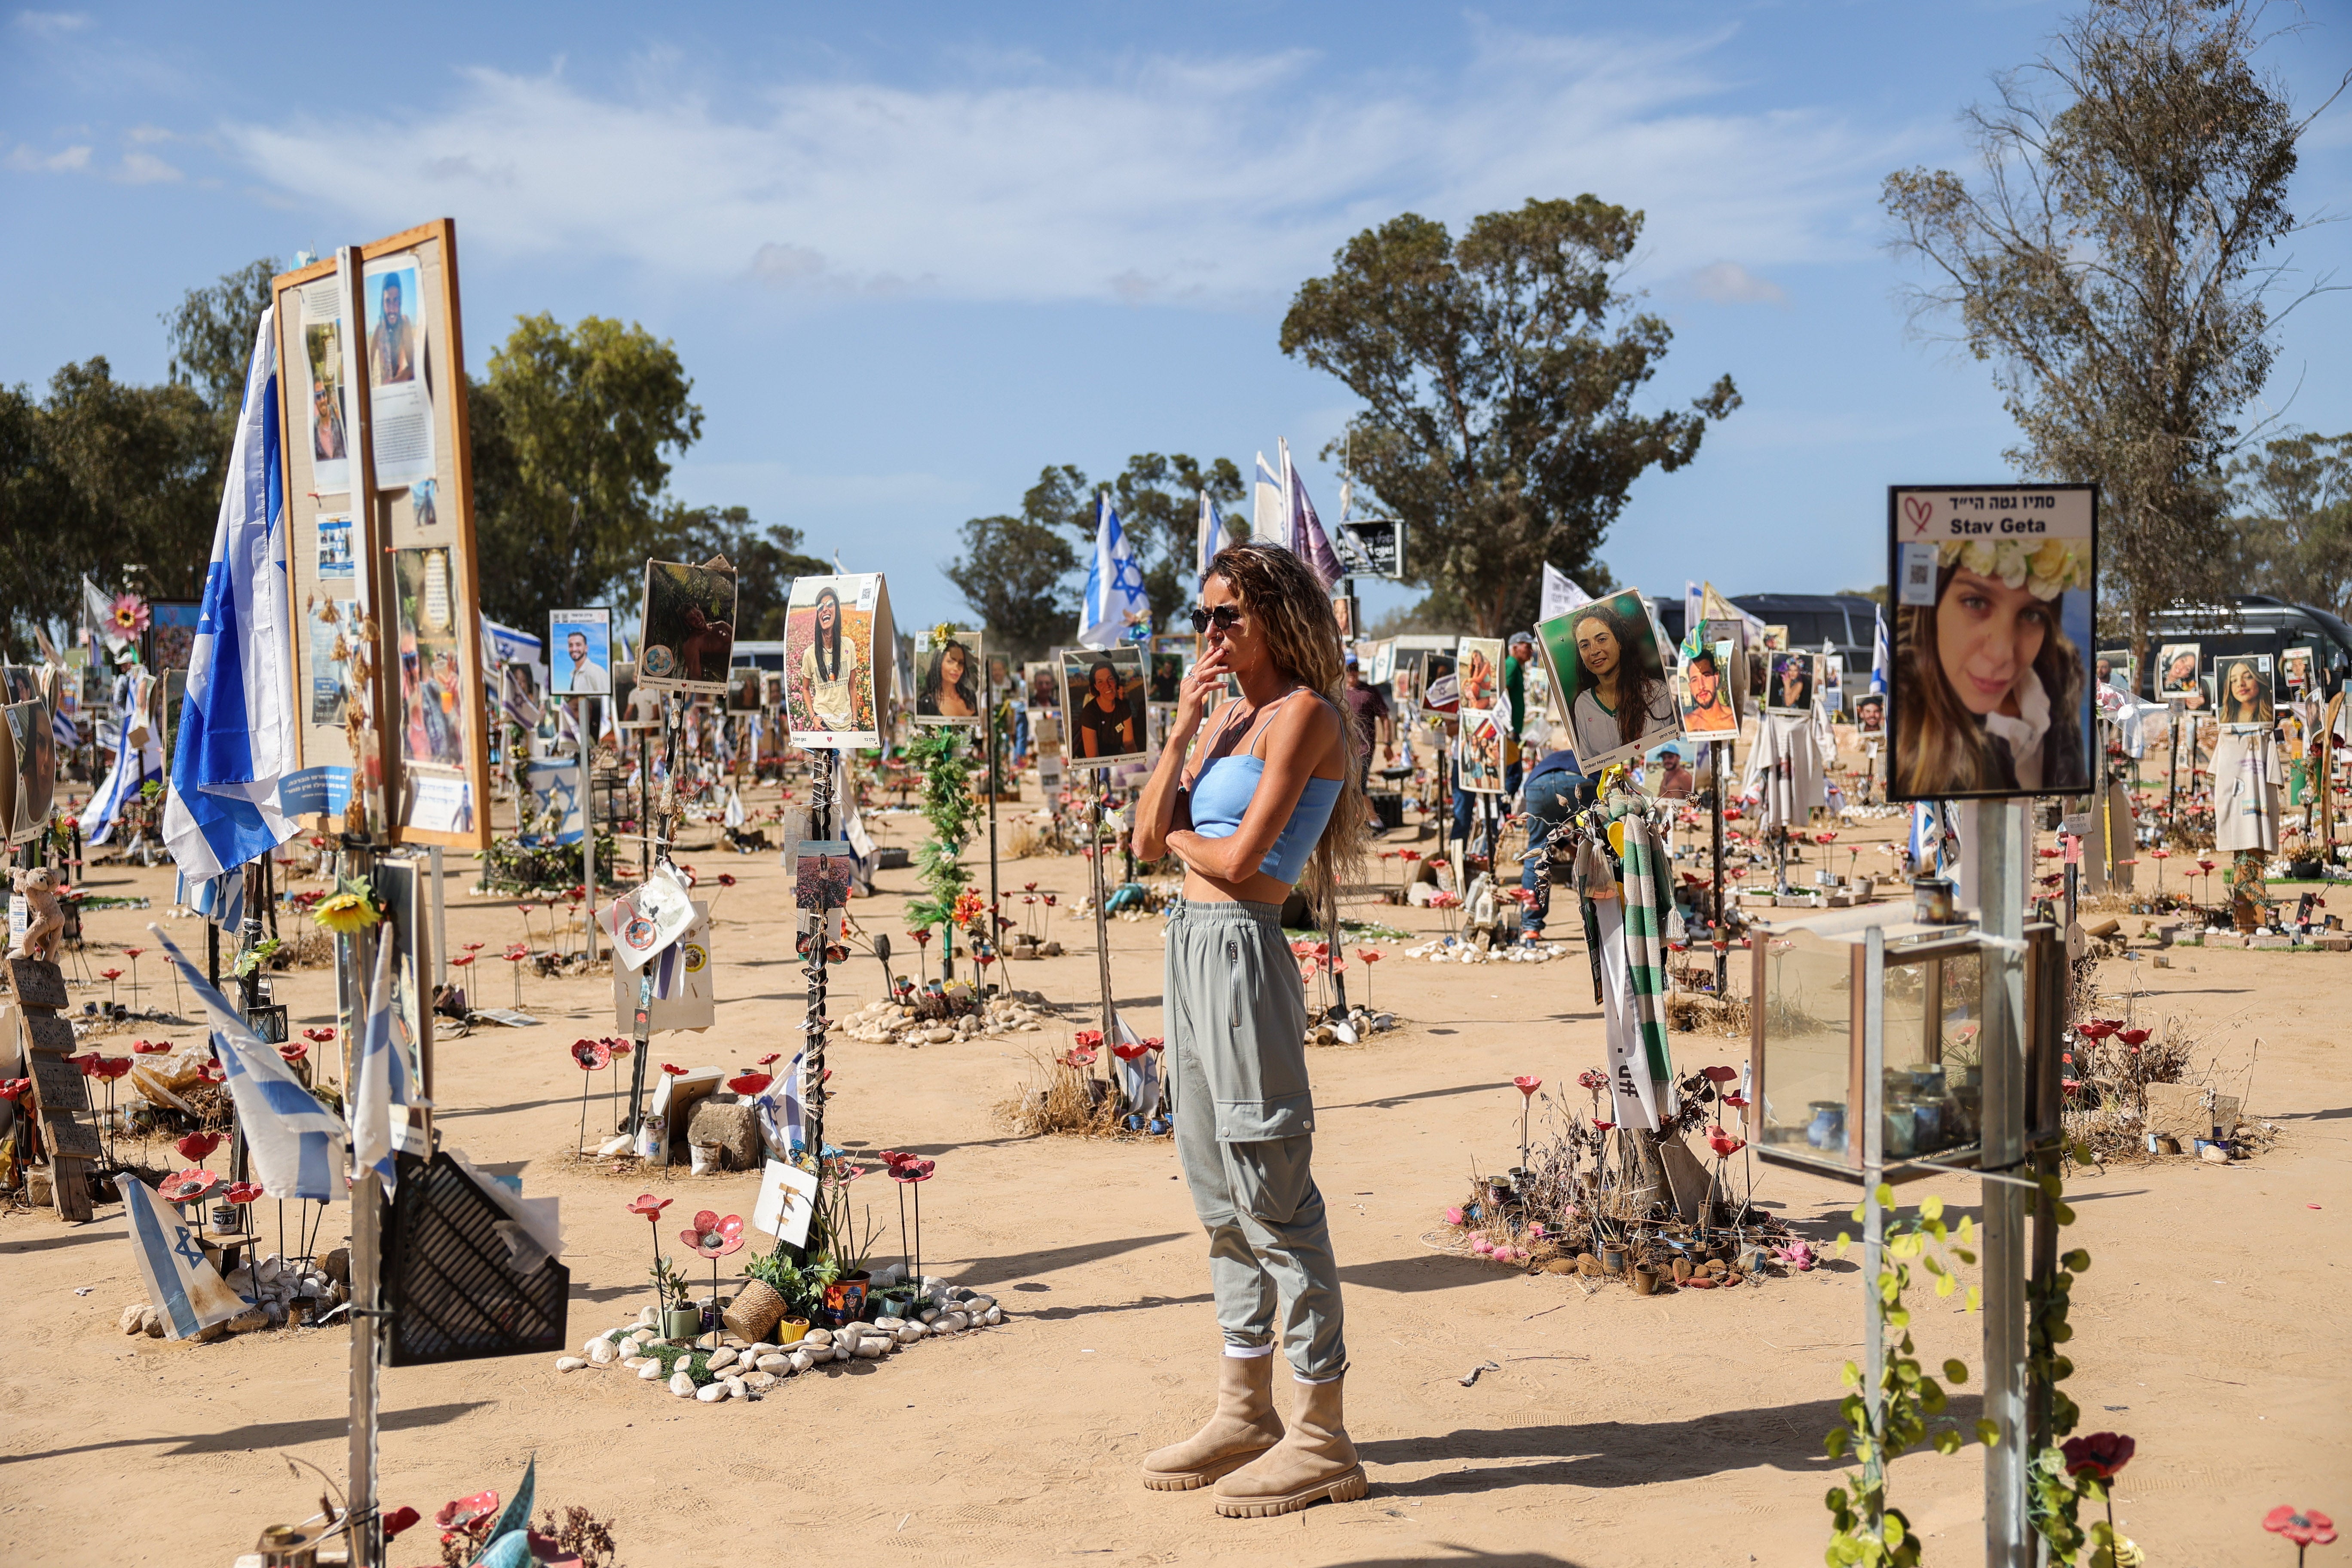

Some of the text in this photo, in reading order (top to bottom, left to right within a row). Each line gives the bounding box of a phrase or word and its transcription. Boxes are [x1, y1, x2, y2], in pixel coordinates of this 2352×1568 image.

[1989, 496, 2017, 509] גטה
[2023, 496, 2055, 508] סתיו
[1950, 518, 2046, 534] Stav Geta
[1597, 755, 1616, 765] Hayman
[1590, 947, 1600, 964] BRI
[214, 1216, 226, 1224] נשמה
